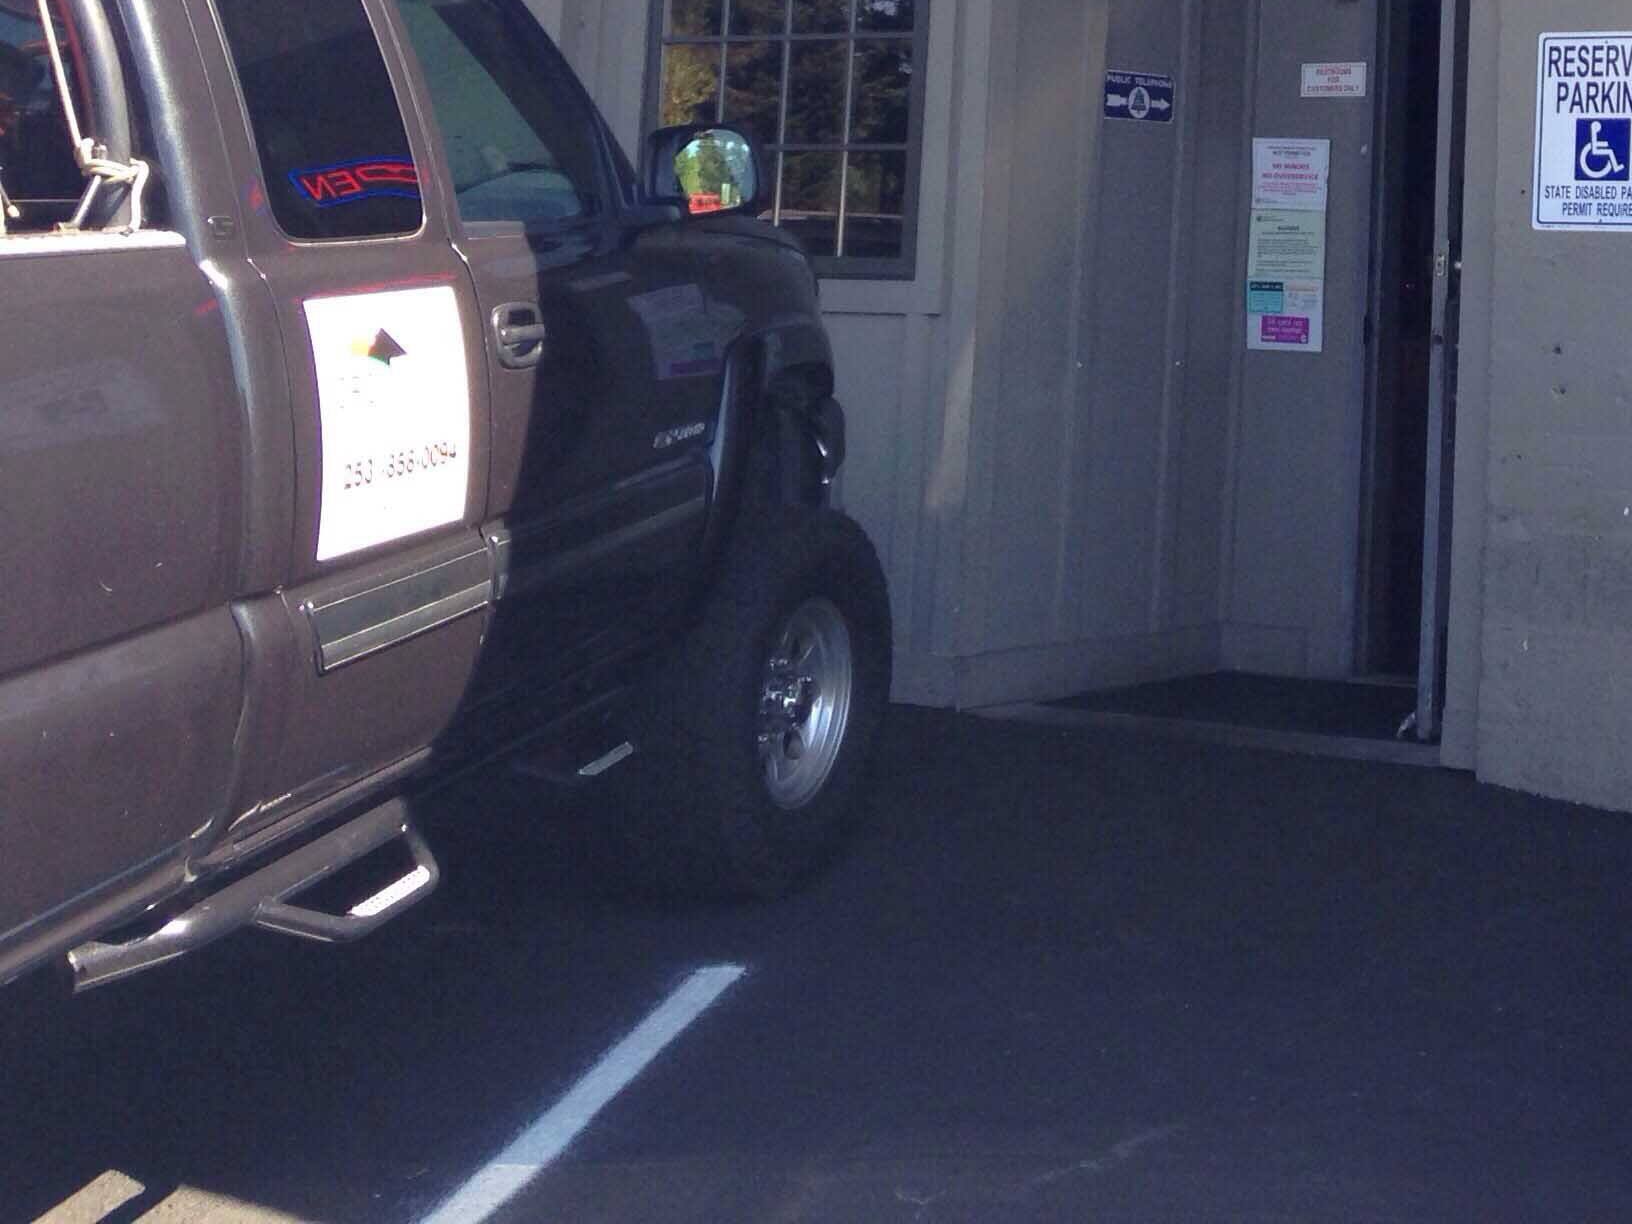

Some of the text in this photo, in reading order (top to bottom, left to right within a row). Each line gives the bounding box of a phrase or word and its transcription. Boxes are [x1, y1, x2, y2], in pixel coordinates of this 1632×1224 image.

[1544, 185, 1572, 199] STATE
[1575, 185, 1617, 200] DISABLED
[1562, 202, 1593, 216] PERMIT
